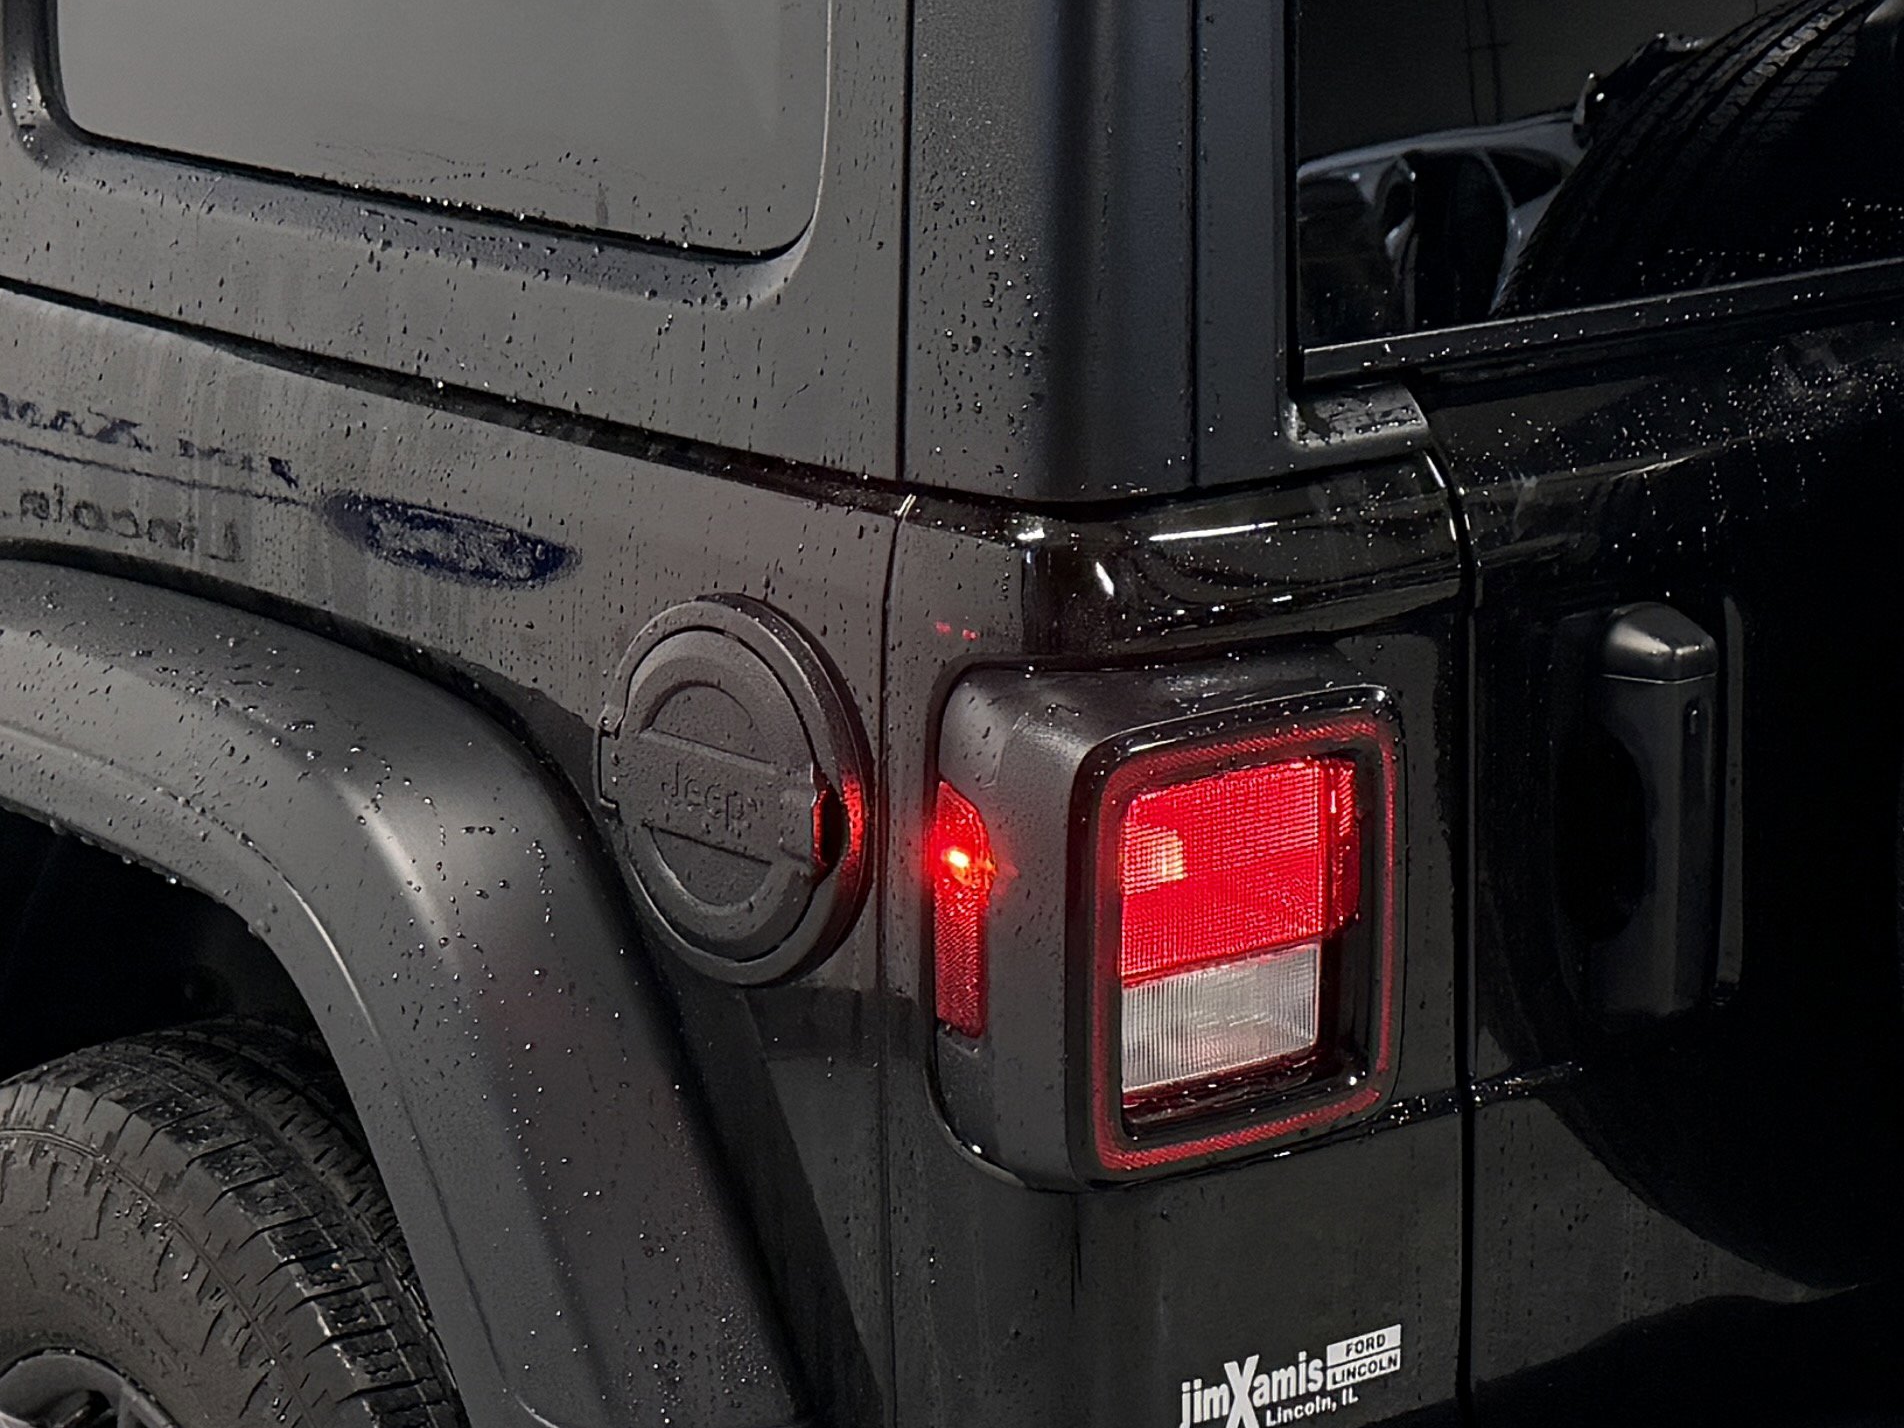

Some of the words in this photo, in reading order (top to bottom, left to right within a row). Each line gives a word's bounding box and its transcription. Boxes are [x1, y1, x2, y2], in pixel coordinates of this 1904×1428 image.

[1345, 1333, 1386, 1357] FORD
[1330, 1354, 1398, 1384] LINCOLN
[1265, 1394, 1338, 1428] Lincoln,
[1341, 1386, 1360, 1407] IL
